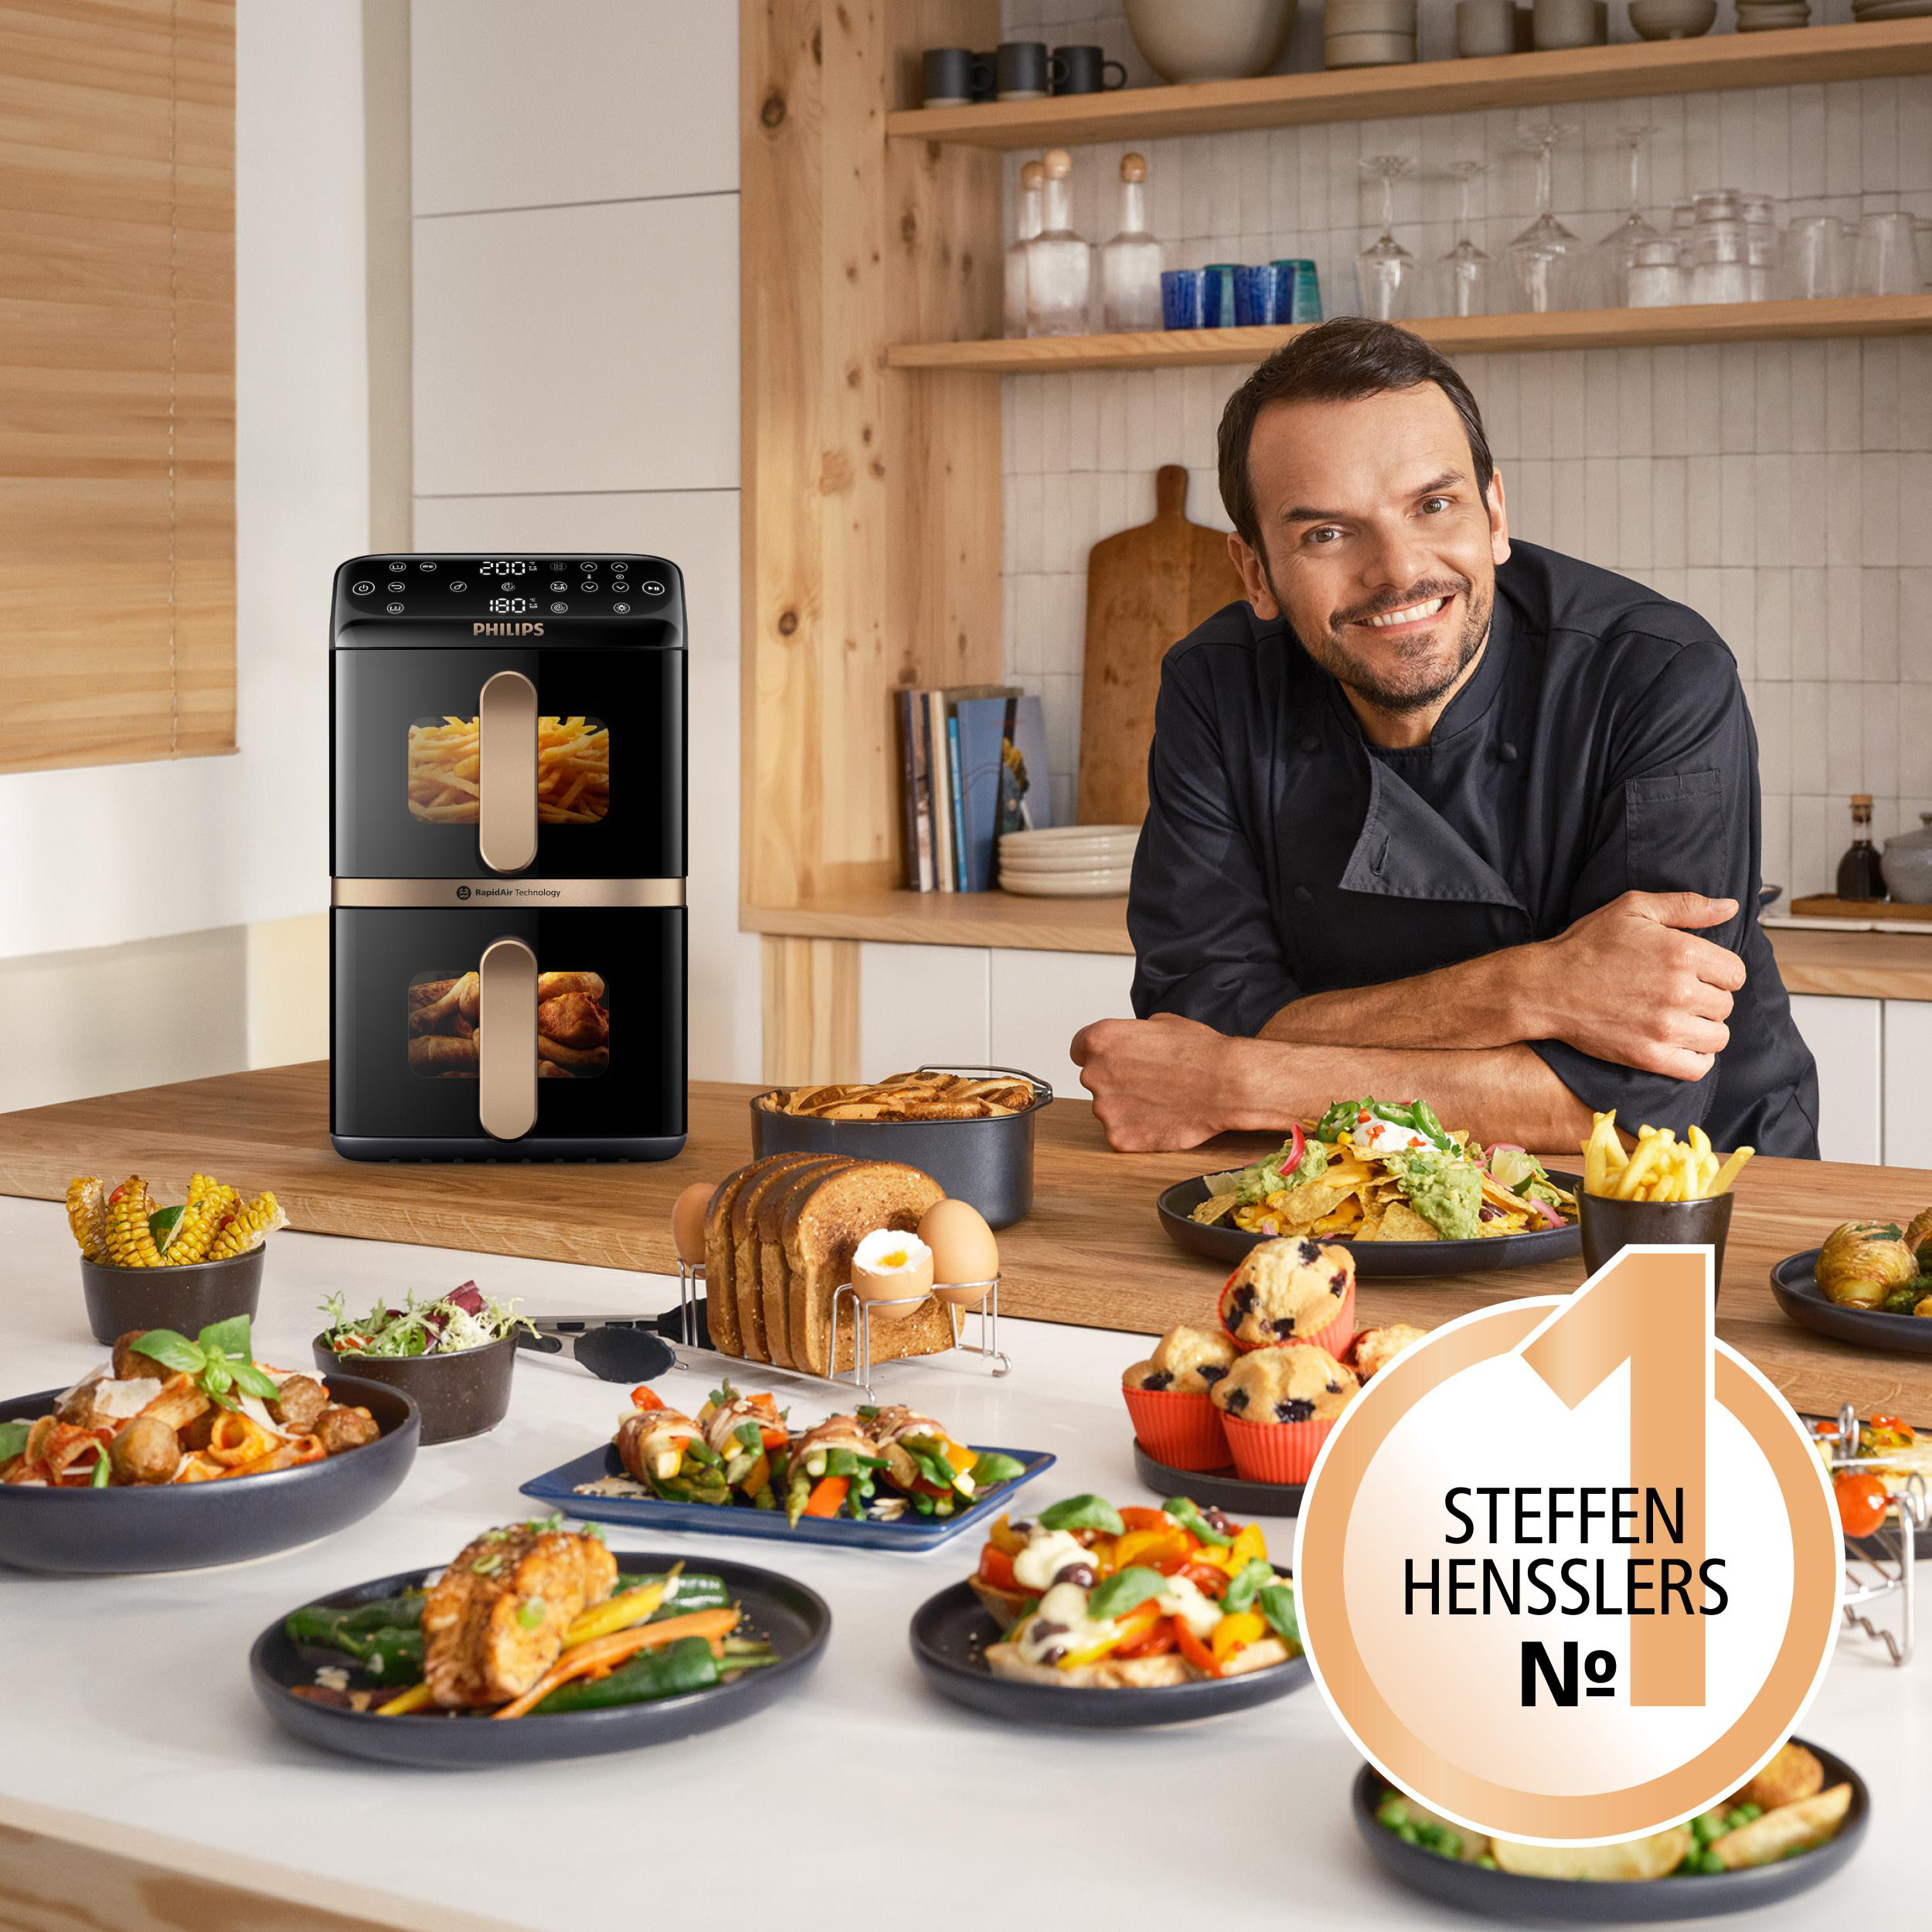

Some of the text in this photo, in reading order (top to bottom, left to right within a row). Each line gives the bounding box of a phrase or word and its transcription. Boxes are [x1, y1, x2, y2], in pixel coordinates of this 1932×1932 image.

[479, 561, 526, 575] 200
[489, 598, 526, 613] 180
[473, 622, 545, 636] PHILIPS
[475, 889, 561, 898] RapidAir Technology
